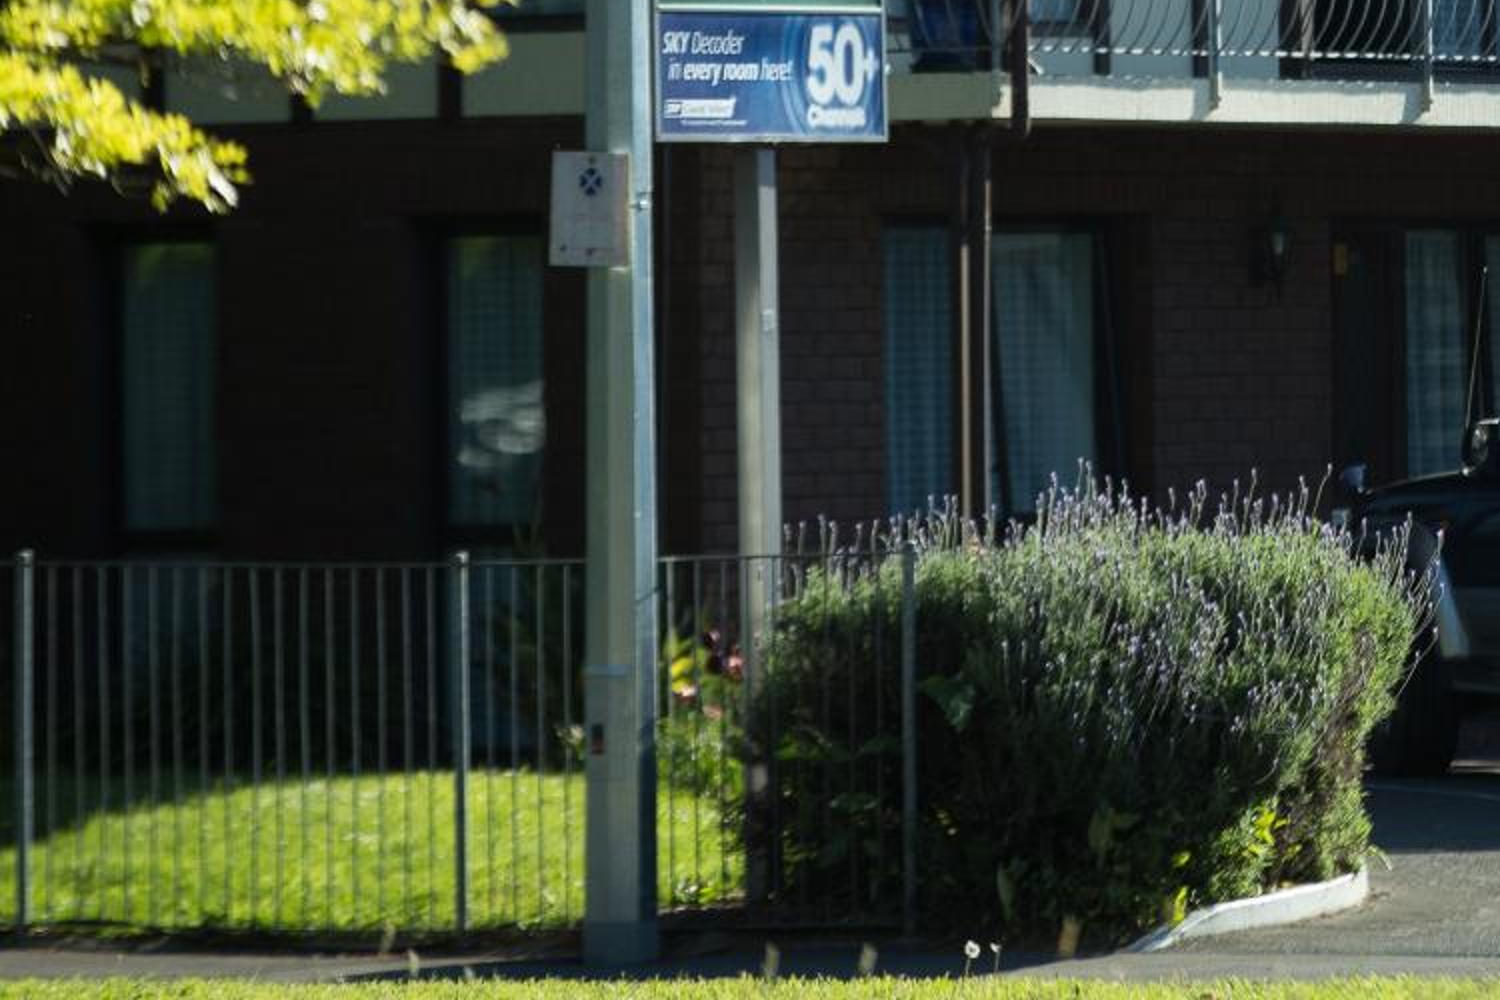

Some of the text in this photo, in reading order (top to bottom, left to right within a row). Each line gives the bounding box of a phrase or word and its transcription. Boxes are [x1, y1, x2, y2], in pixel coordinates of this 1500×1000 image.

[662, 30, 745, 54] SKY Decoder
[668, 57, 795, 87] in every room here!
